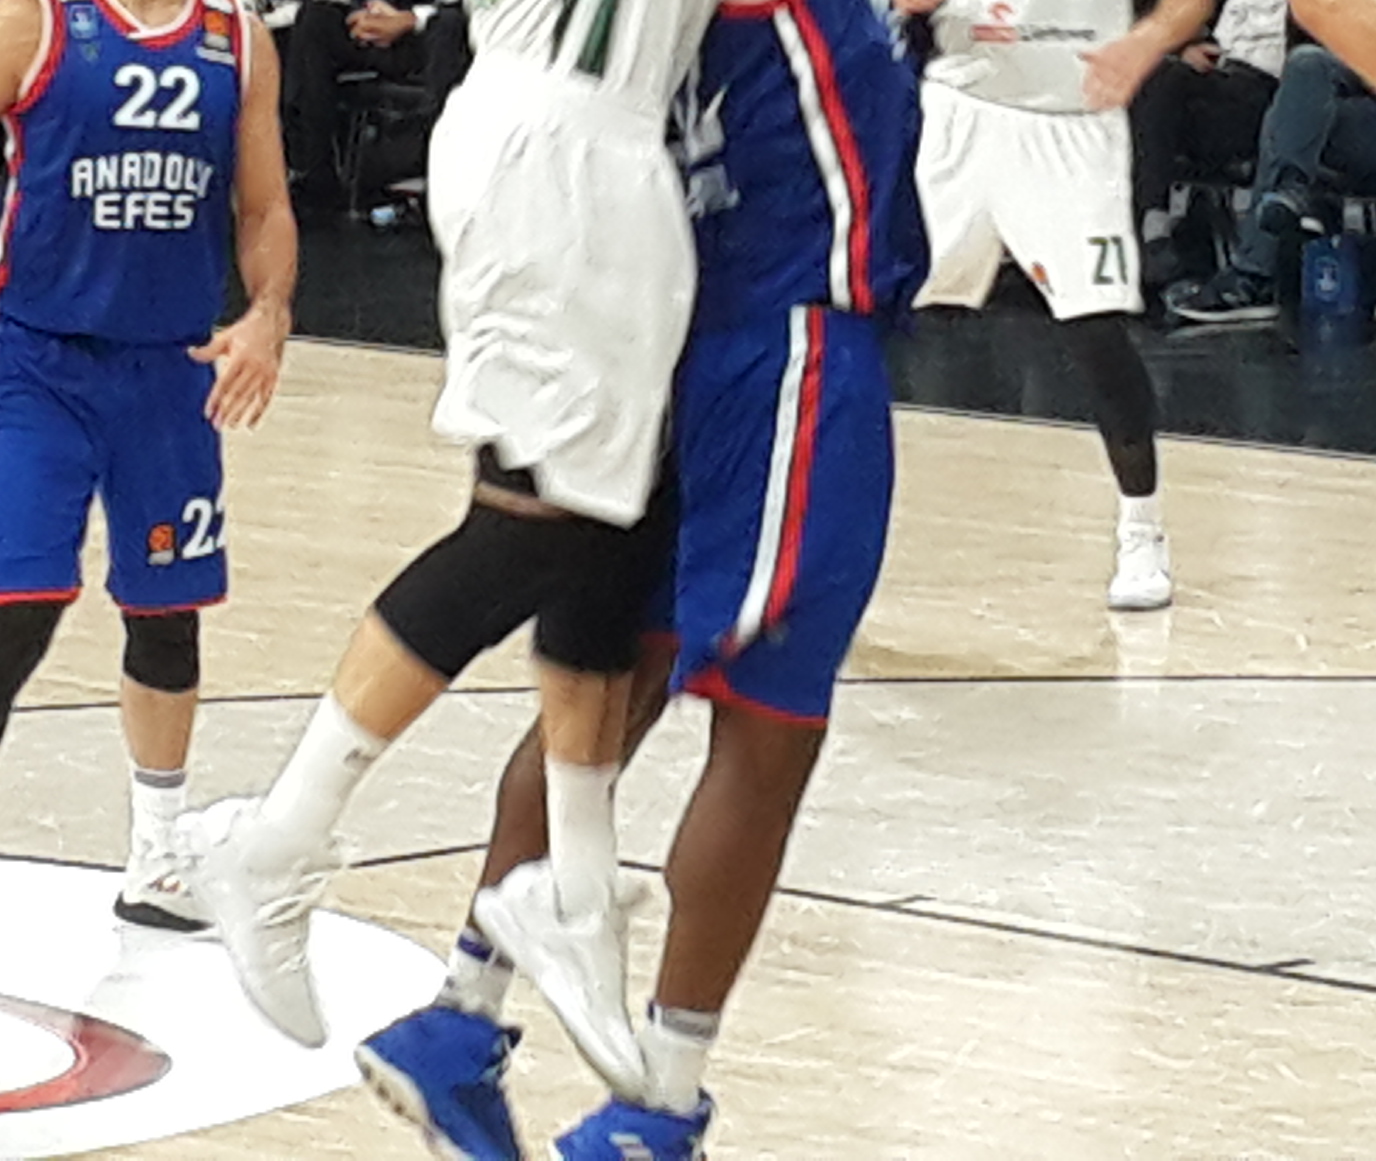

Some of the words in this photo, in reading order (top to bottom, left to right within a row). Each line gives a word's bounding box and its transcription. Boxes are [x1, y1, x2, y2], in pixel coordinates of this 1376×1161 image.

[113, 64, 201, 130] 22
[72, 151, 214, 199] ANADOLU
[93, 191, 196, 231] EFES
[1087, 236, 1128, 286] 21
[182, 498, 226, 559] 2
